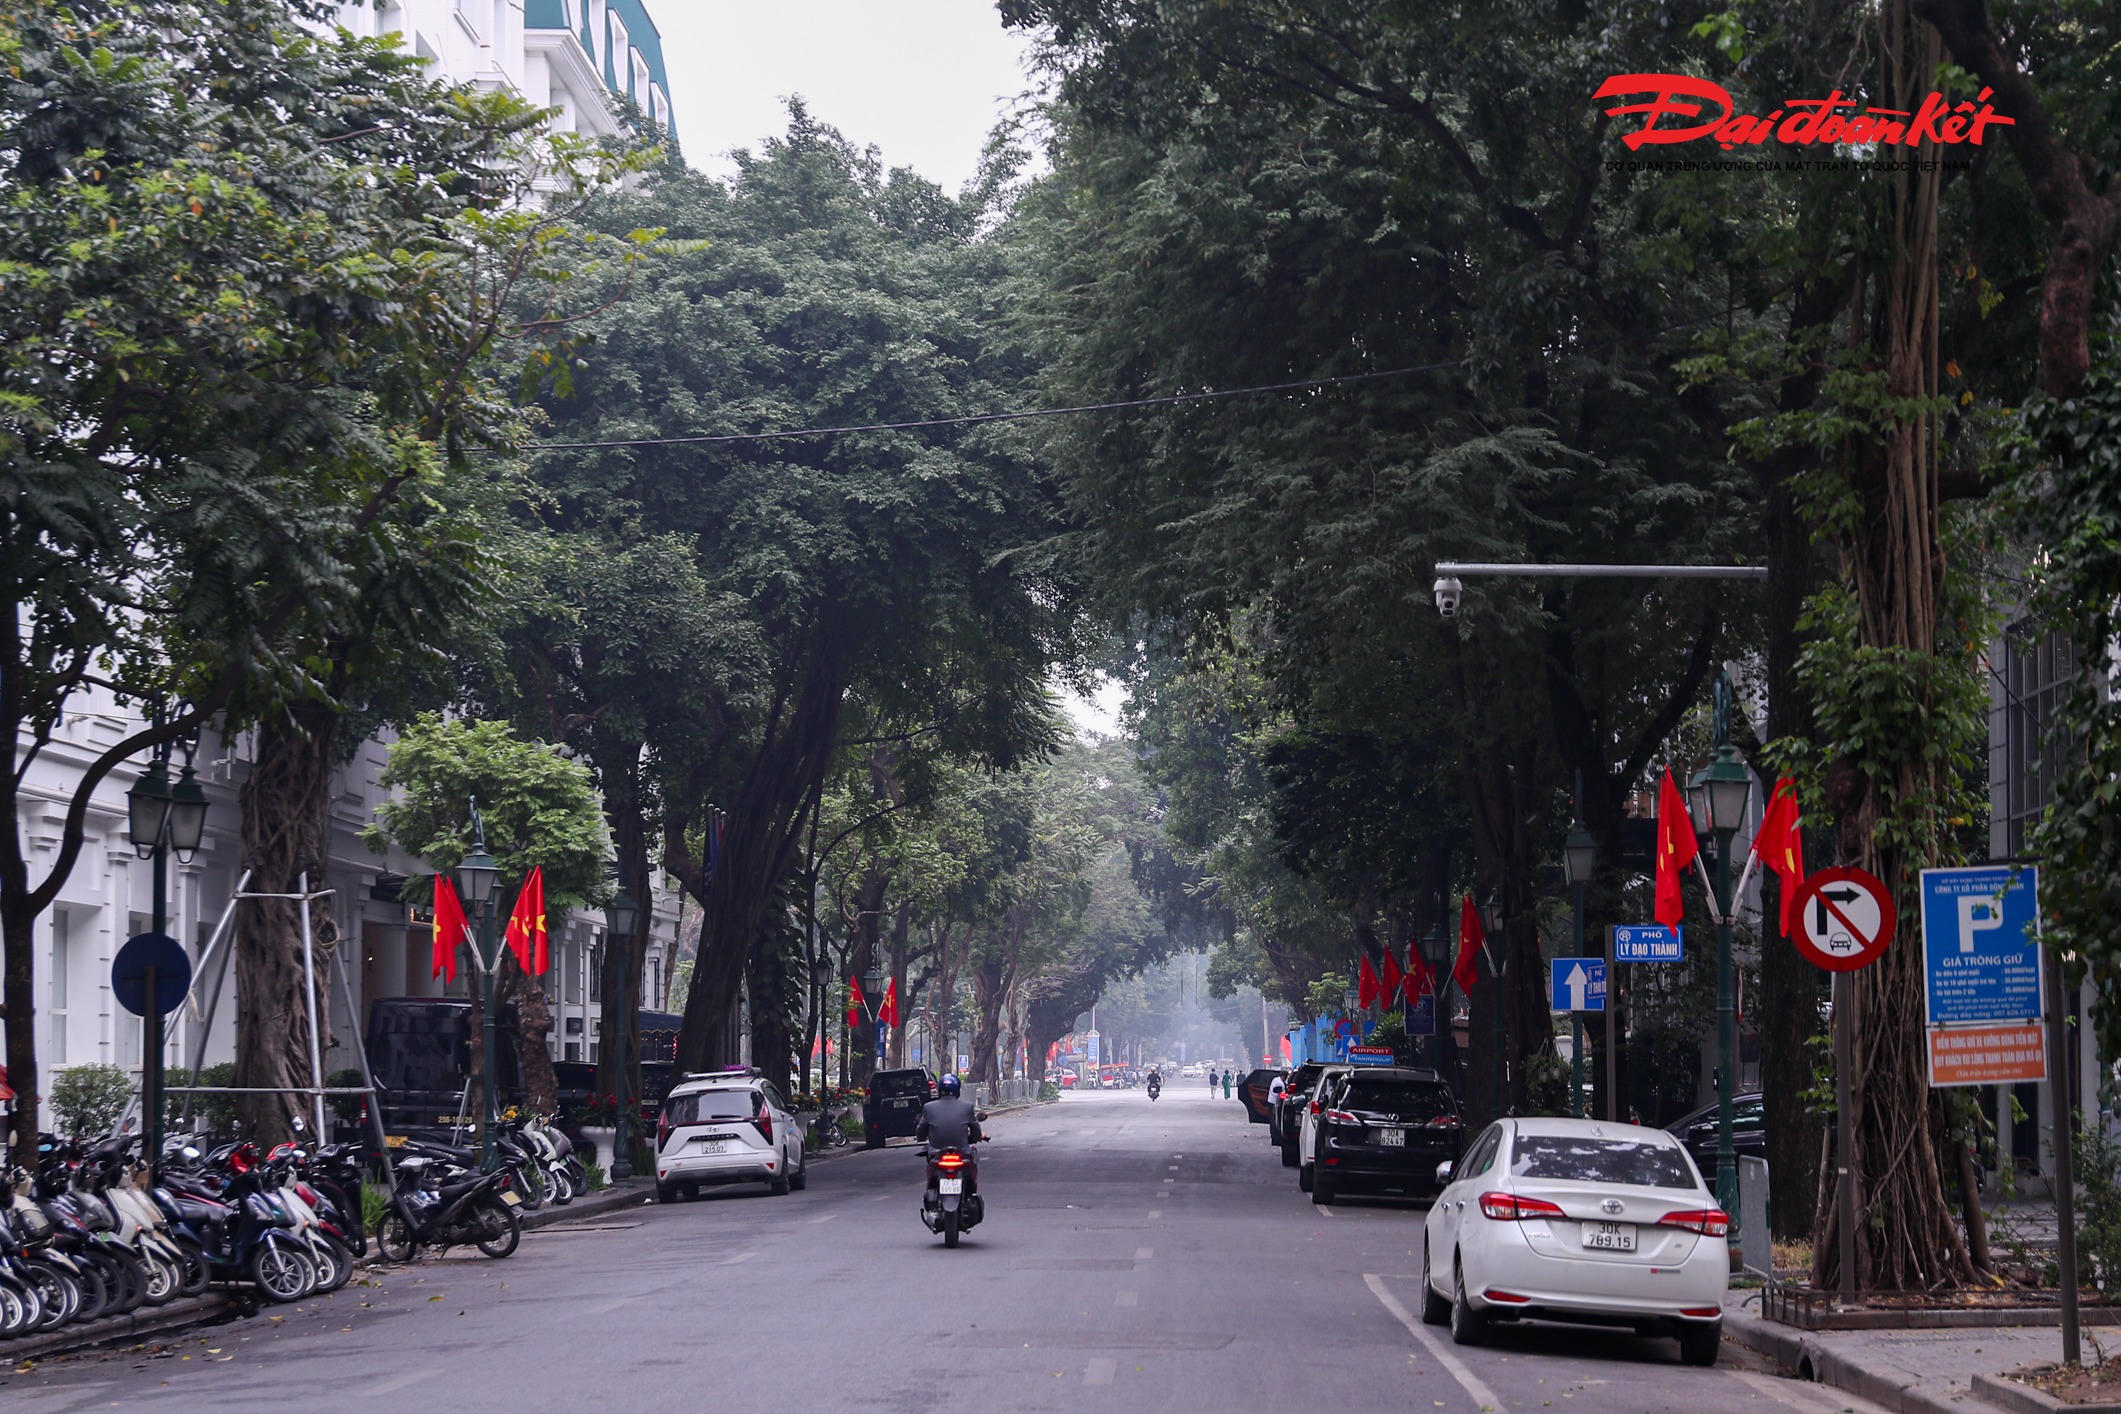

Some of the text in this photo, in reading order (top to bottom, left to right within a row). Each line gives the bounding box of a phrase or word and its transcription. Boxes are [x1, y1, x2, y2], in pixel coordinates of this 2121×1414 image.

[1641, 929, 1664, 939] PHỐ
[1631, 943, 1648, 958] ĐẠO
[1650, 940, 1678, 956] THÀNH
[1943, 955, 1962, 968] GIÁ
[1963, 953, 2002, 967] TRÔNG
[1352, 1047, 1389, 1055] AIRPORT
[1599, 1222, 1621, 1235] 30K
[1589, 1234, 1631, 1248] 789.15
